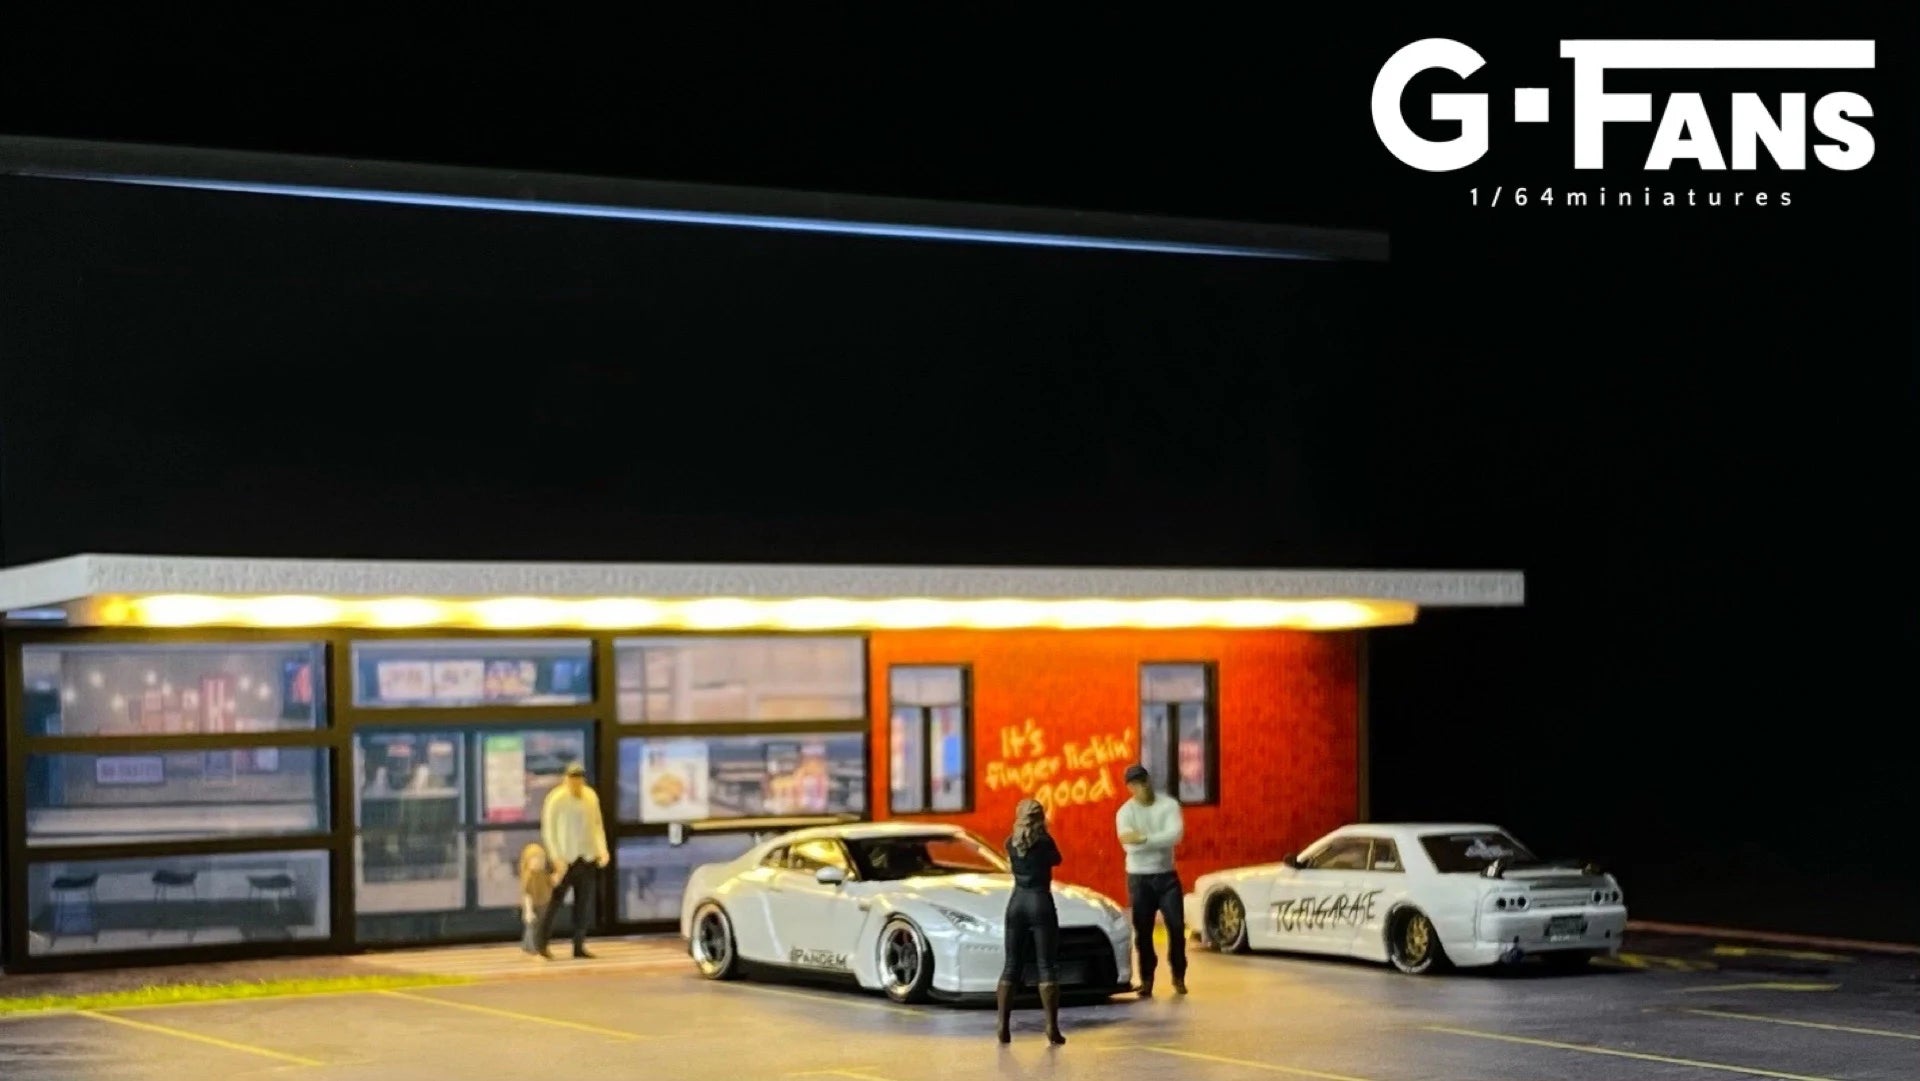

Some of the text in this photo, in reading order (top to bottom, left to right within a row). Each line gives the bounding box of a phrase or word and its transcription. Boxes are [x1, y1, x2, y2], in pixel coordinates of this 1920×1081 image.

[985, 726, 1133, 792] finger lickin'
[1000, 718, 1045, 759] It's
[1035, 764, 1116, 822] good
